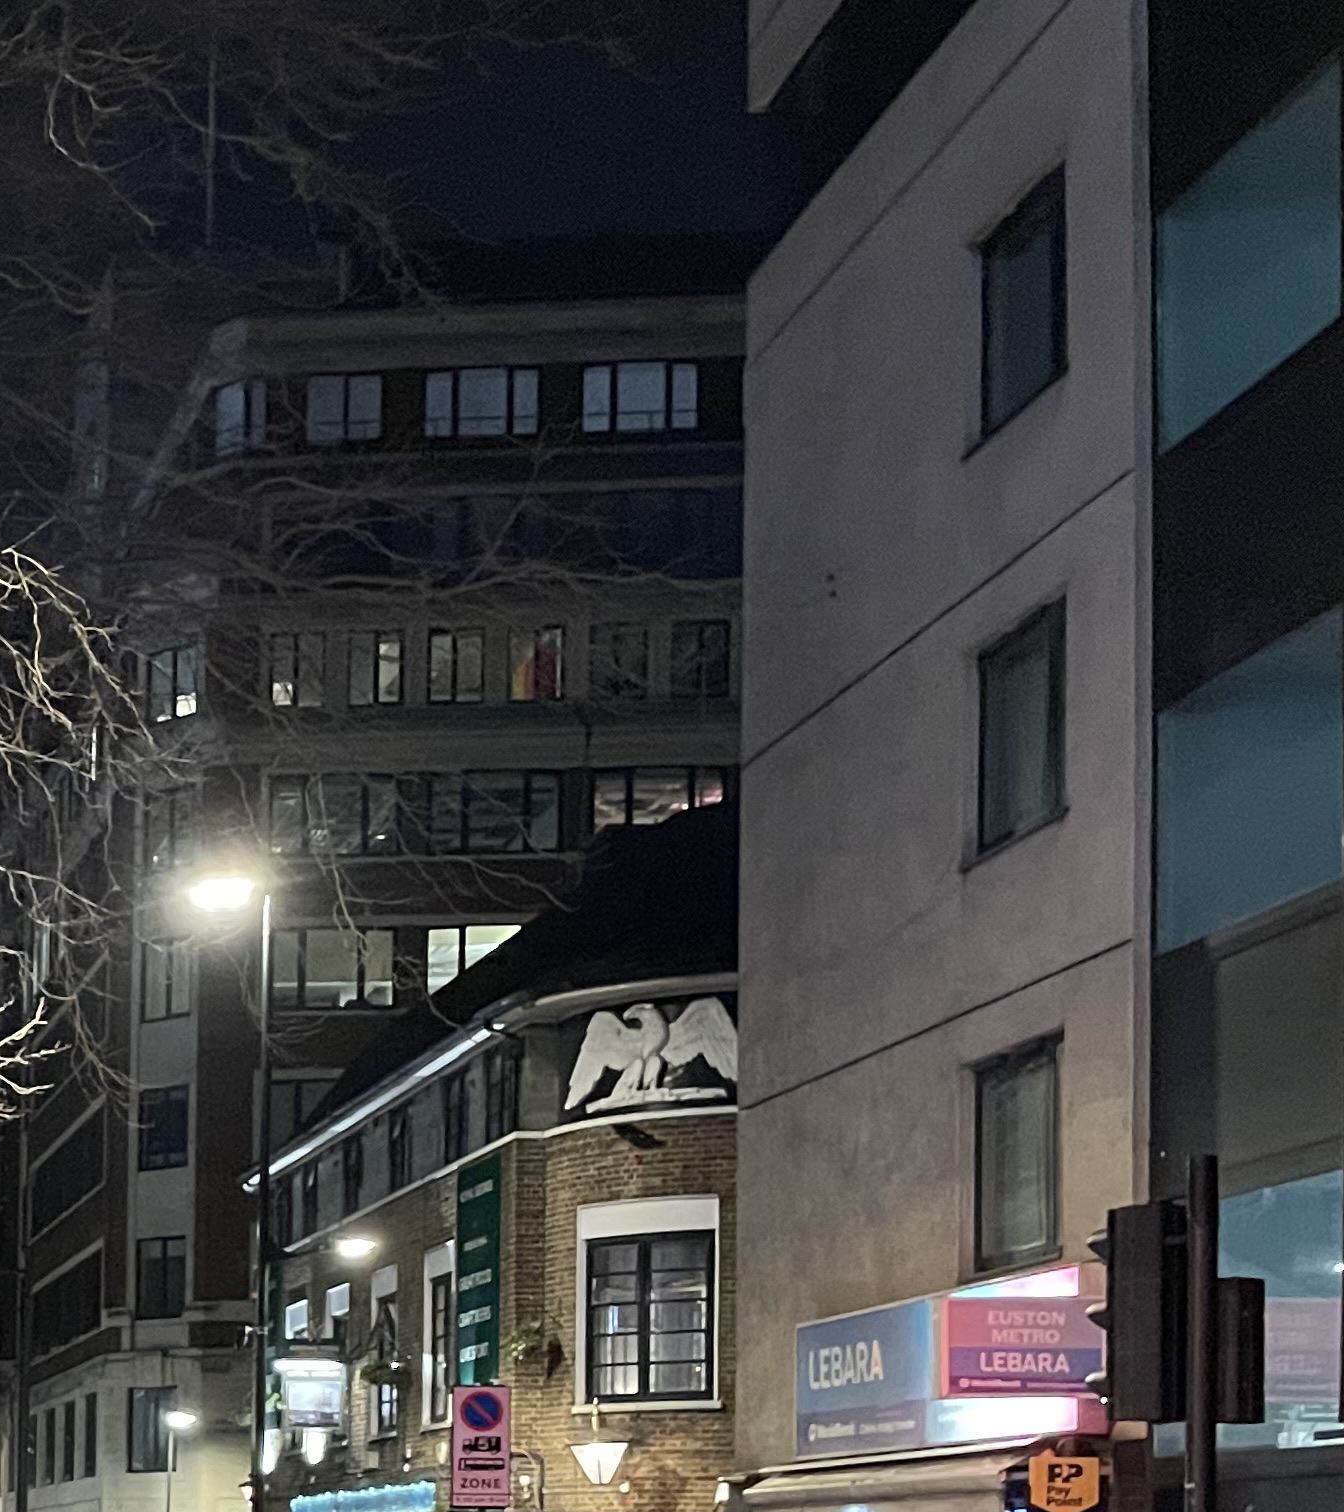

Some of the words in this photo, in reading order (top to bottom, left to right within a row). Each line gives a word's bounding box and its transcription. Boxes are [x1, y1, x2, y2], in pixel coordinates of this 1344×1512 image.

[988, 1310, 1066, 1326] EUSTON
[992, 1328, 1060, 1344] METRO
[809, 1340, 884, 1390] LEBARA
[979, 1351, 1070, 1373] LEBARA
[460, 1478, 501, 1489] ZONE
